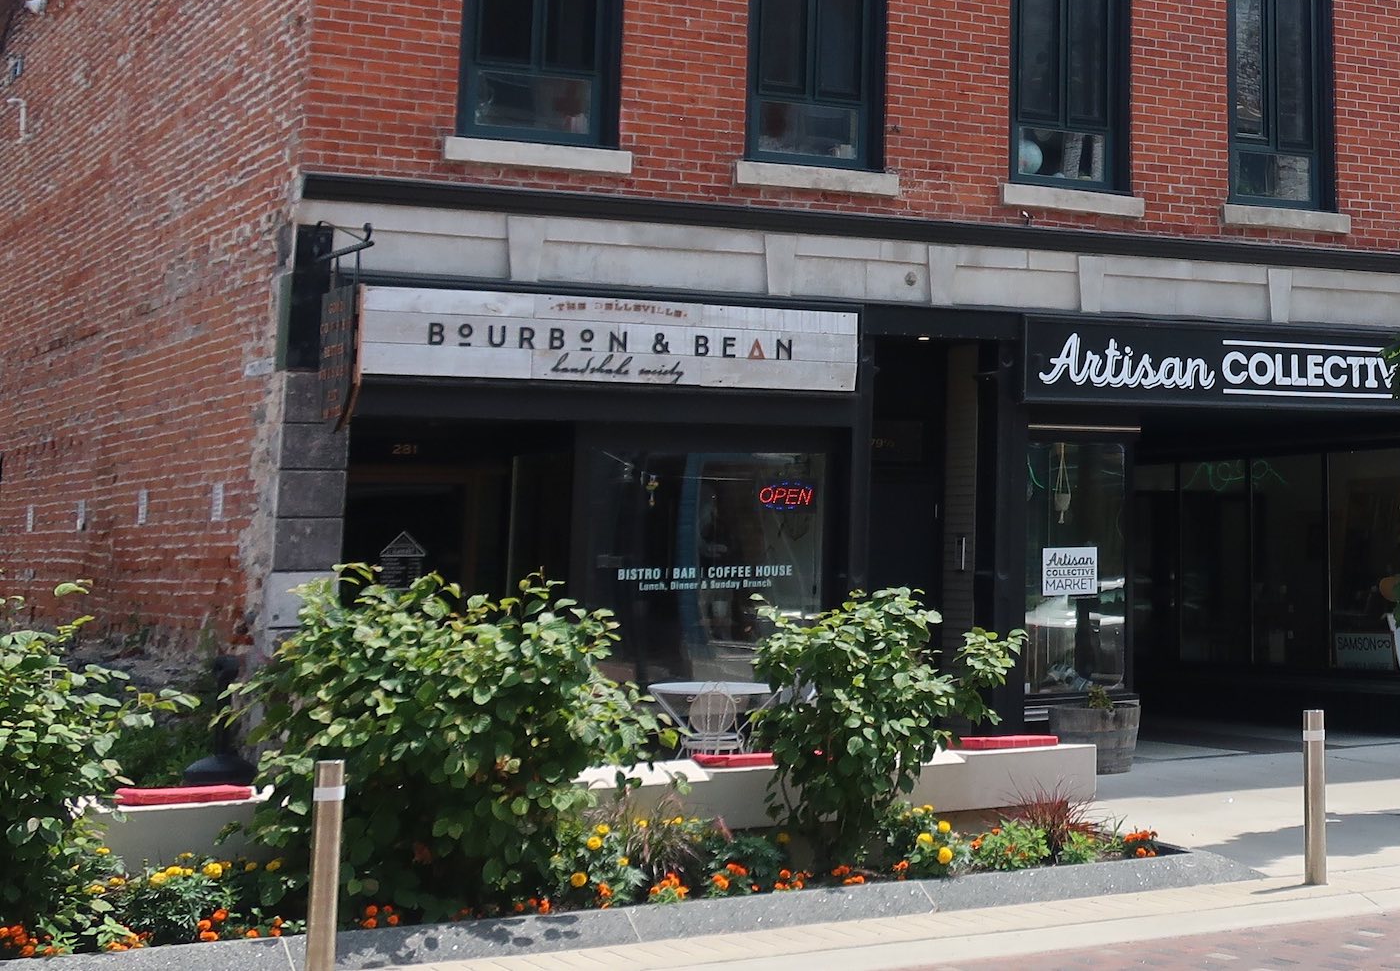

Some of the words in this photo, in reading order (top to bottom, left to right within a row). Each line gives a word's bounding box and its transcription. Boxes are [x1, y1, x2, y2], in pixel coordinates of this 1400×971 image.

[554, 301, 587, 311] THE
[652, 332, 670, 354] &
[694, 334, 792, 360] BEAN
[550, 352, 632, 375] handshake
[1038, 332, 1216, 389] Artisan
[759, 487, 813, 505] OPEN
[1045, 552, 1095, 566] Artisan
[617, 568, 661, 580] BISTRO
[673, 567, 696, 579] BAR
[708, 566, 751, 578] COFFEE
[755, 565, 793, 577] HOUSE
[1045, 568, 1095, 577] COLLECTIVE
[1045, 578, 1095, 591] MARKET
[1337, 636, 1377, 651] SAMSON
